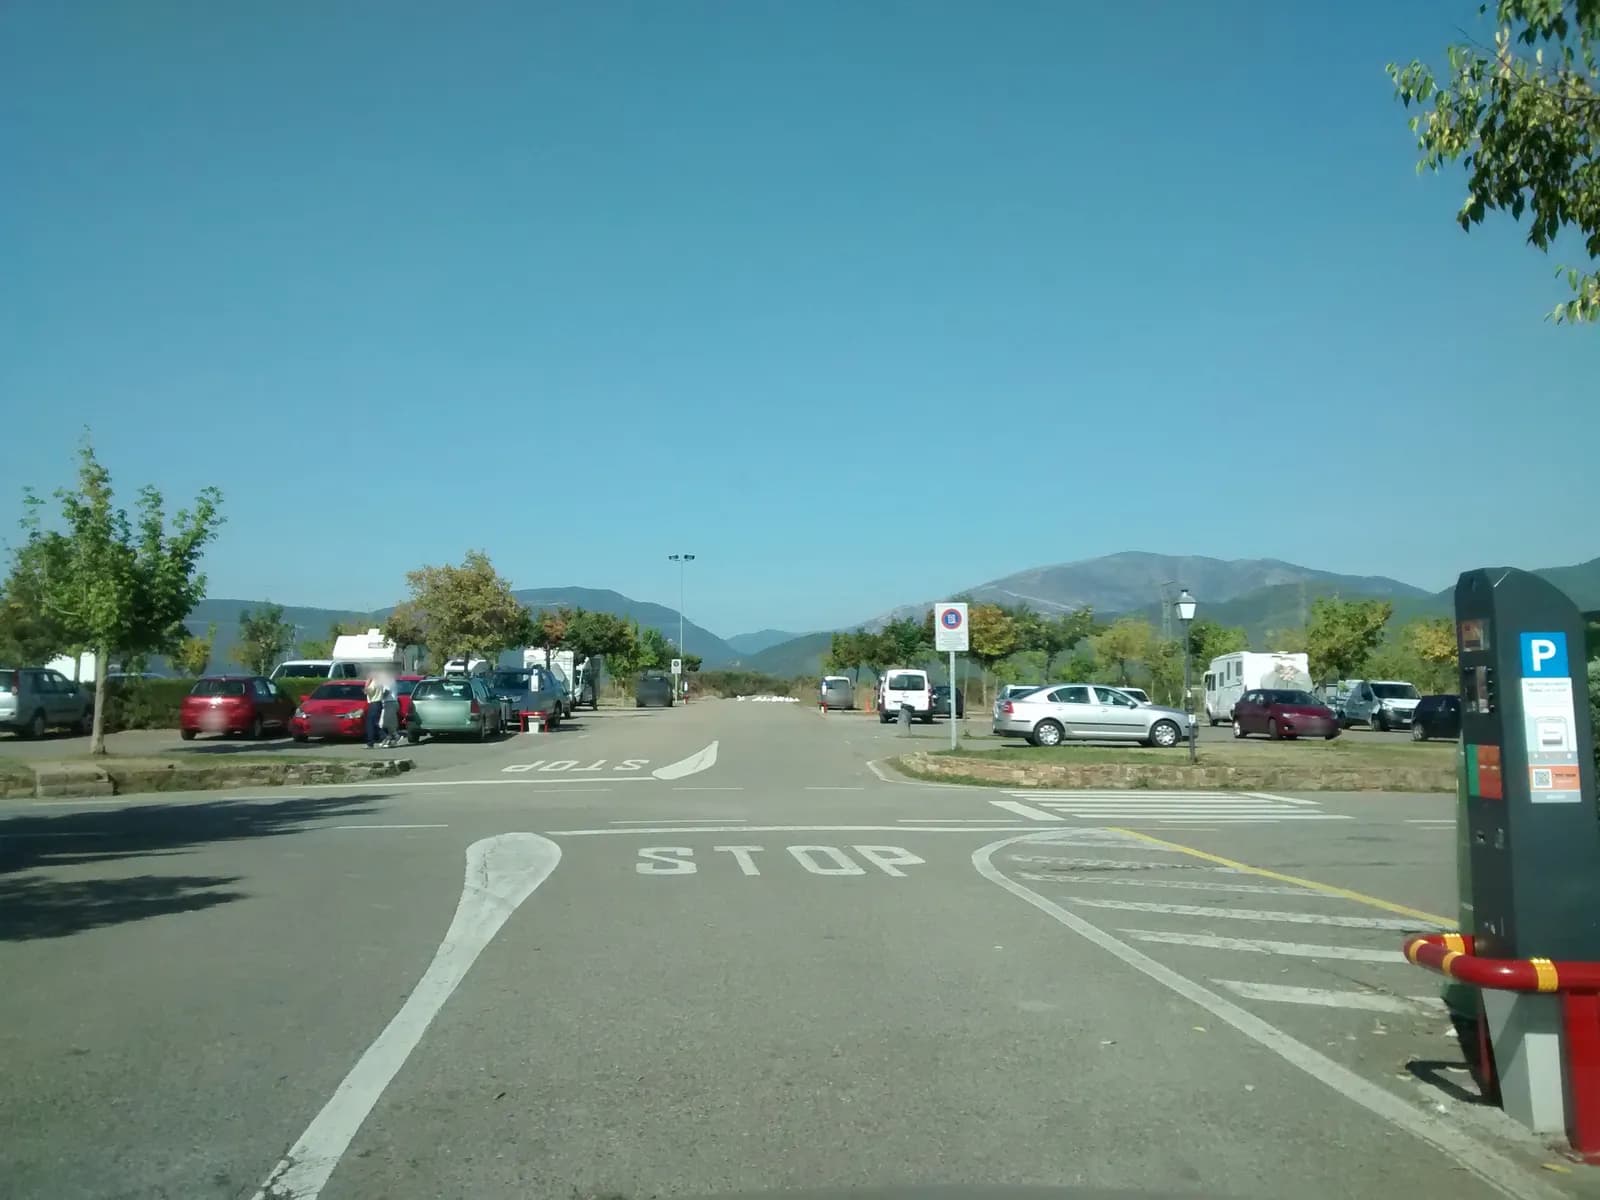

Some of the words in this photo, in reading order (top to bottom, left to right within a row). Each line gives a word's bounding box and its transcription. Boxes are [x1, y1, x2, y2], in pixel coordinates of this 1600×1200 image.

[1531, 639, 1556, 672] P
[501, 759, 650, 773] STOP
[635, 845, 926, 877] STOP
